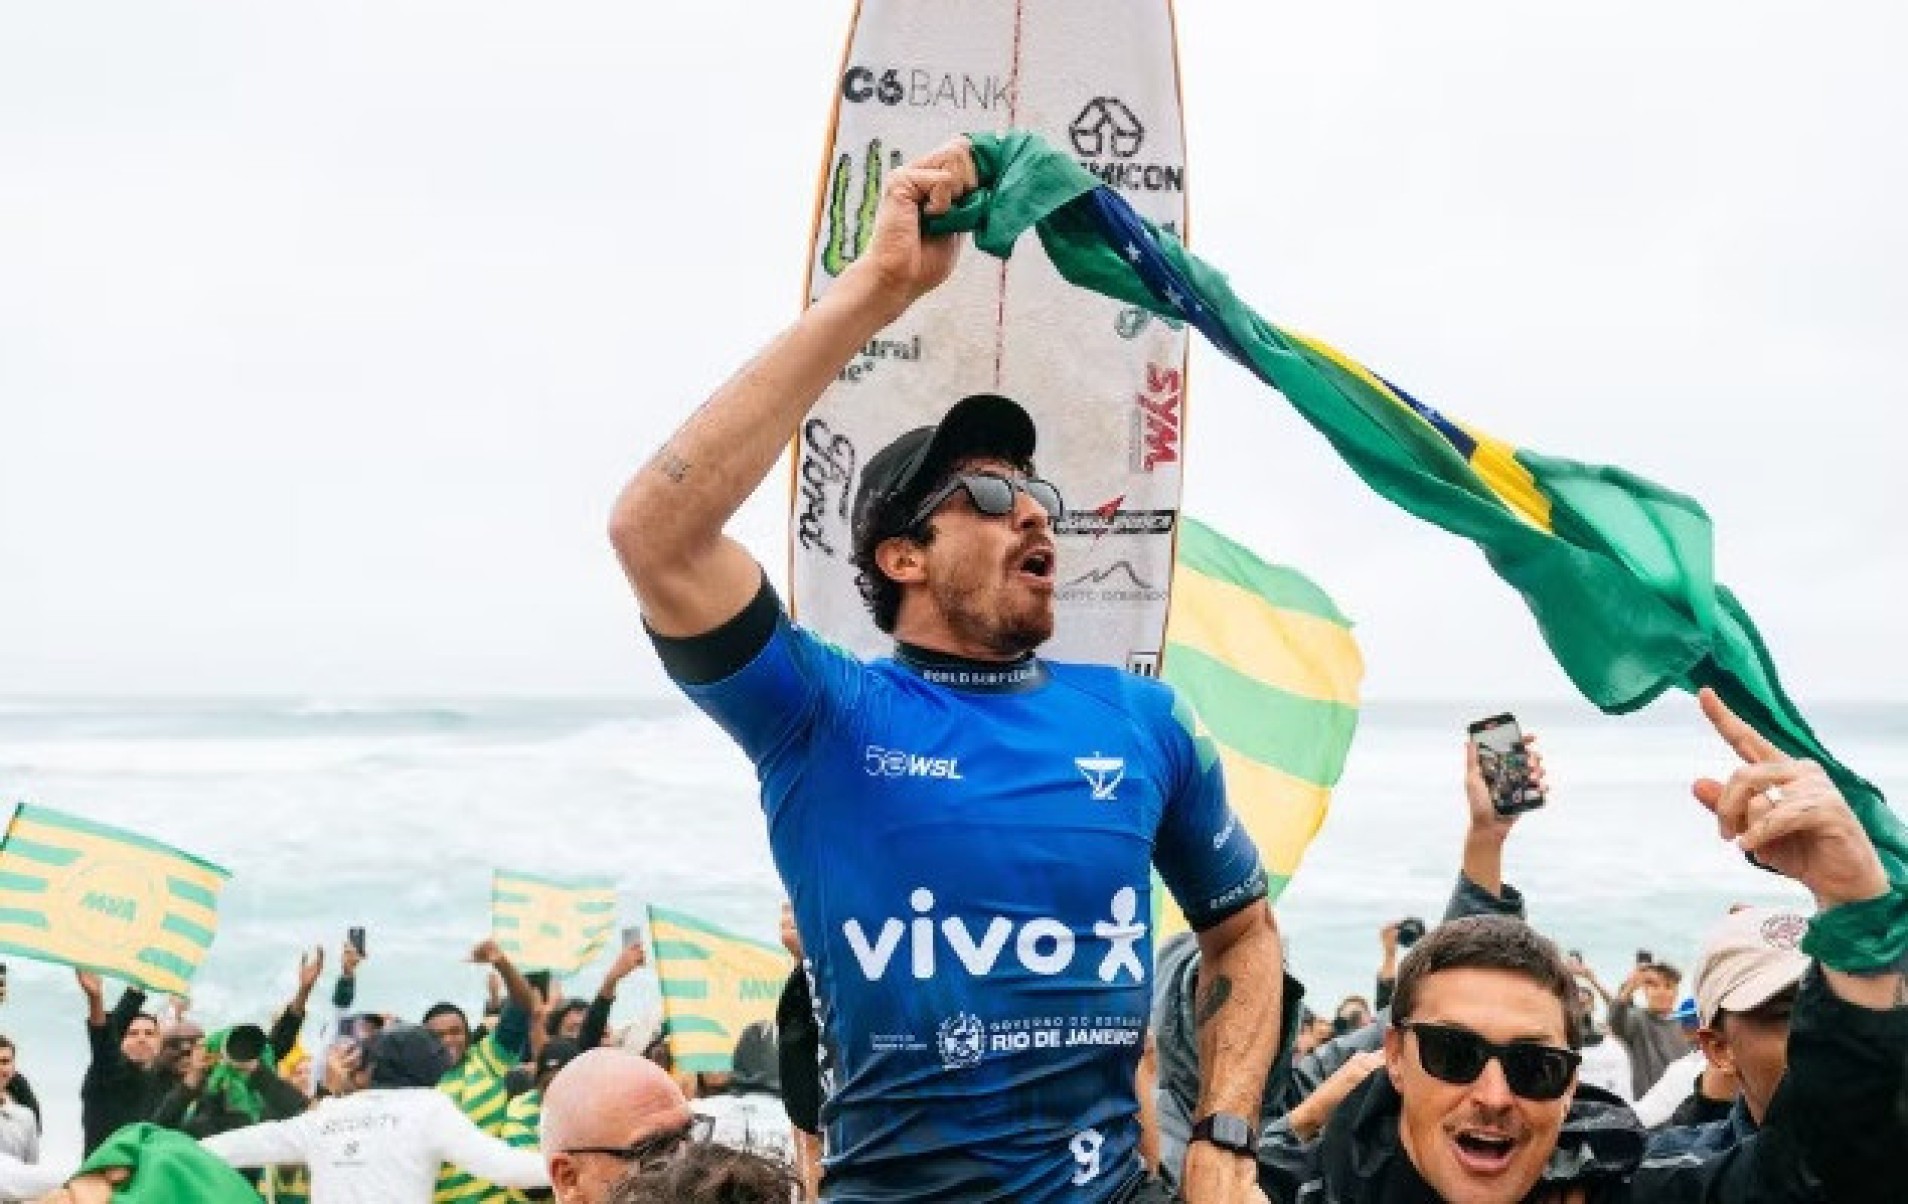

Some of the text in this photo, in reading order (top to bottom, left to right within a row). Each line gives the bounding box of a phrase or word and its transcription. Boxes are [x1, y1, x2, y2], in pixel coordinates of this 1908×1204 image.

[799, 418, 855, 555] Ford
[907, 753, 963, 780] WSL
[842, 887, 1075, 981] vivo
[991, 1027, 1139, 1051] RIO DE JANEIRO
[1068, 1128, 1105, 1187] 9
